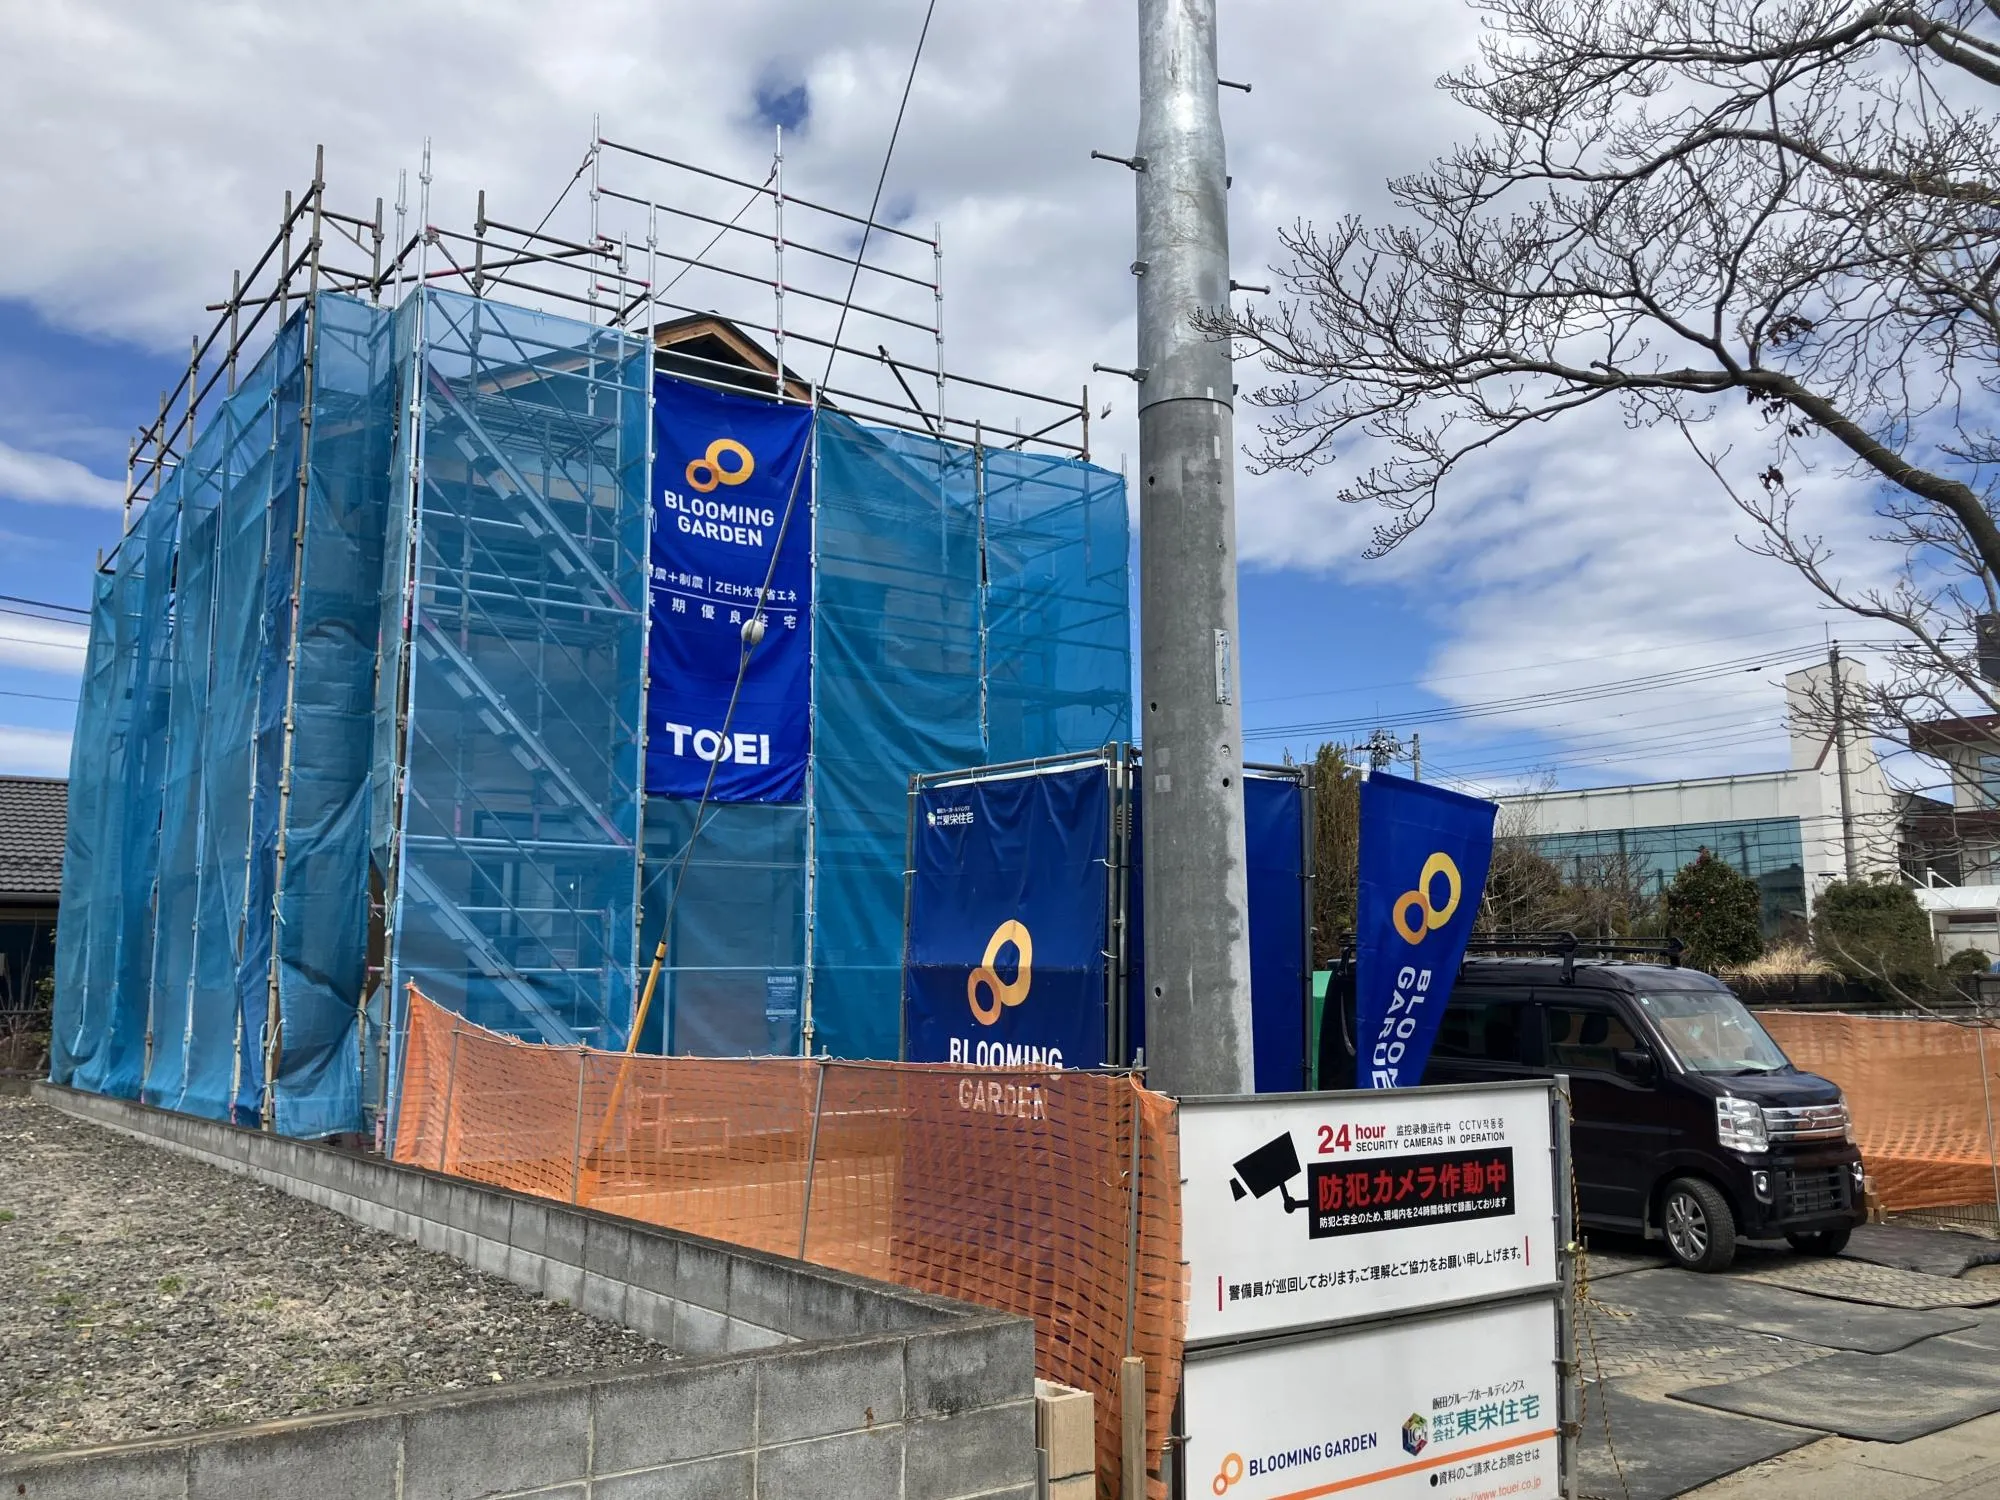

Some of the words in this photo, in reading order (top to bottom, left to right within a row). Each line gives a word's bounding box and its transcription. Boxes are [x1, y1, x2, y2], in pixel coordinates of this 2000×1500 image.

[664, 490, 775, 527] BLOOMING
[678, 515, 763, 547] GARDEN
[665, 722, 770, 765] TOEI
[950, 1037, 1063, 1080] BLOOMING
[958, 1077, 1048, 1120] GARDEN
[1317, 1124, 1351, 1154] 24
[1355, 1124, 1386, 1140] hour
[1356, 1140, 1398, 1152] SECURITY
[1404, 1136, 1443, 1148] CAMERAS
[1447, 1135, 1456, 1145] IN
[1460, 1132, 1505, 1144] OPERATION
[1396, 1122, 1451, 1137] 监控录像运作中
[1318, 1158, 1506, 1211] 防犯カメラ作動中
[1457, 1394, 1540, 1436] 東栄住宅
[1249, 1445, 1321, 1476] BLOOMING
[1325, 1432, 1377, 1458] GARDEN
